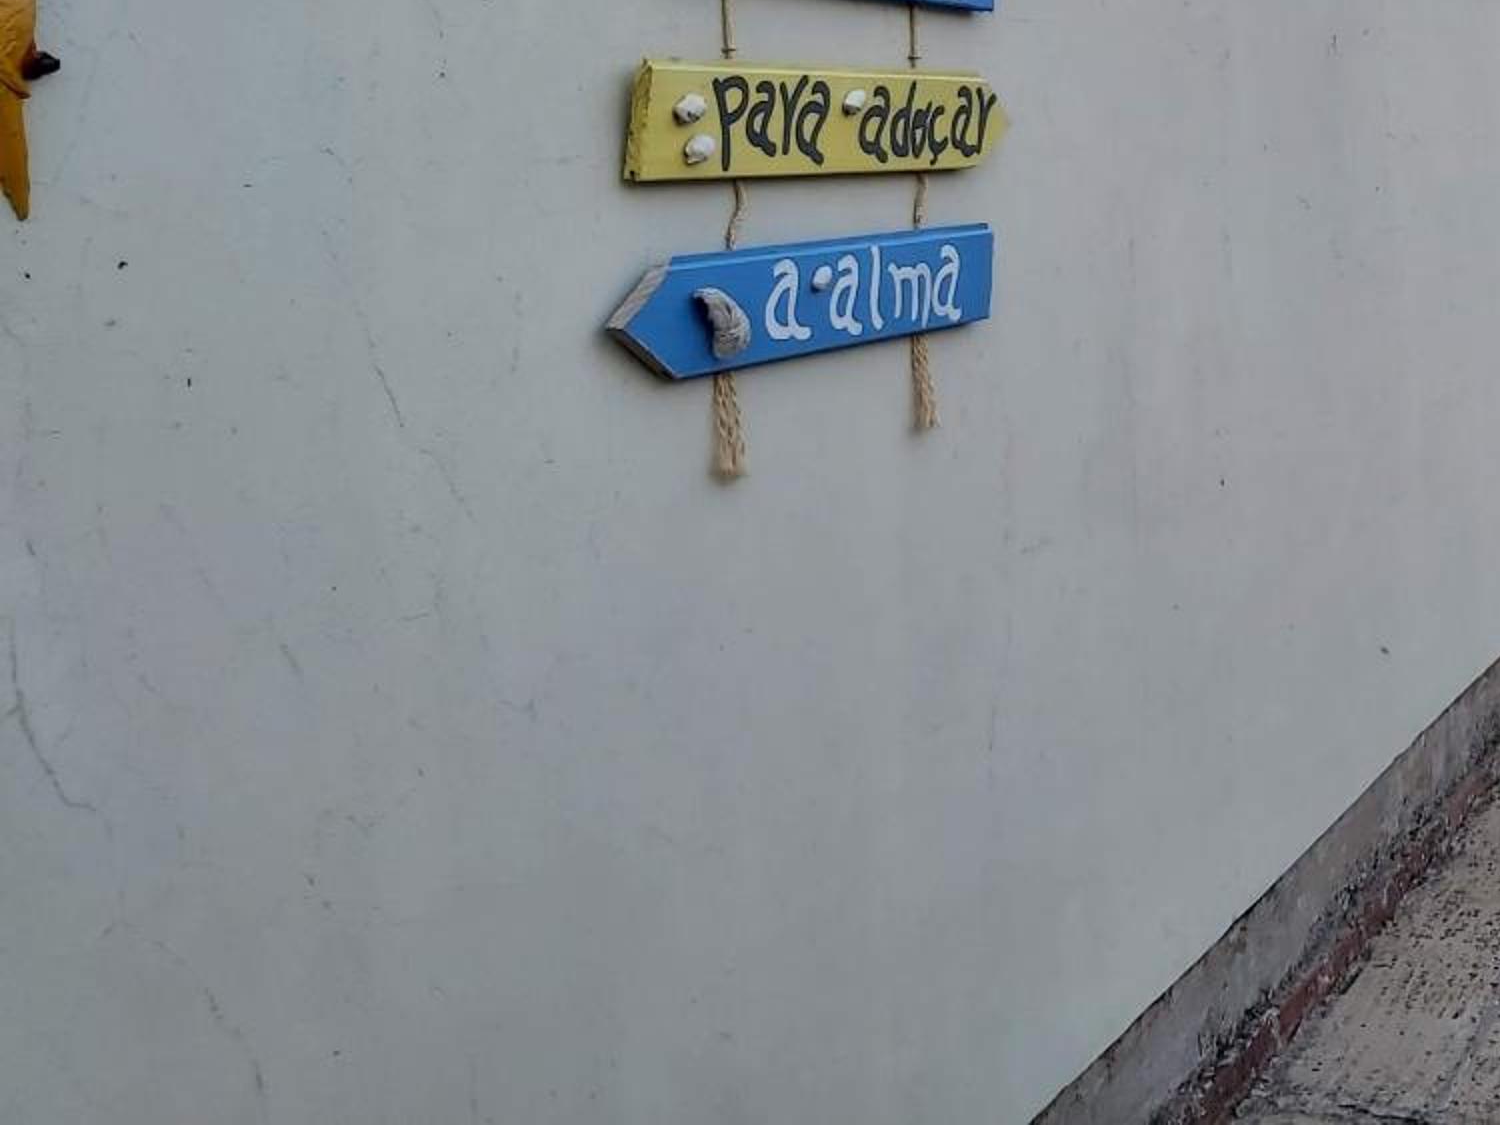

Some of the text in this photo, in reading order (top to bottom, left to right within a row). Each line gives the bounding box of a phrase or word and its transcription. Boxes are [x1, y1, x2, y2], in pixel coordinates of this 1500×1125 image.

[713, 75, 831, 171] para
[765, 243, 962, 341] a alma
